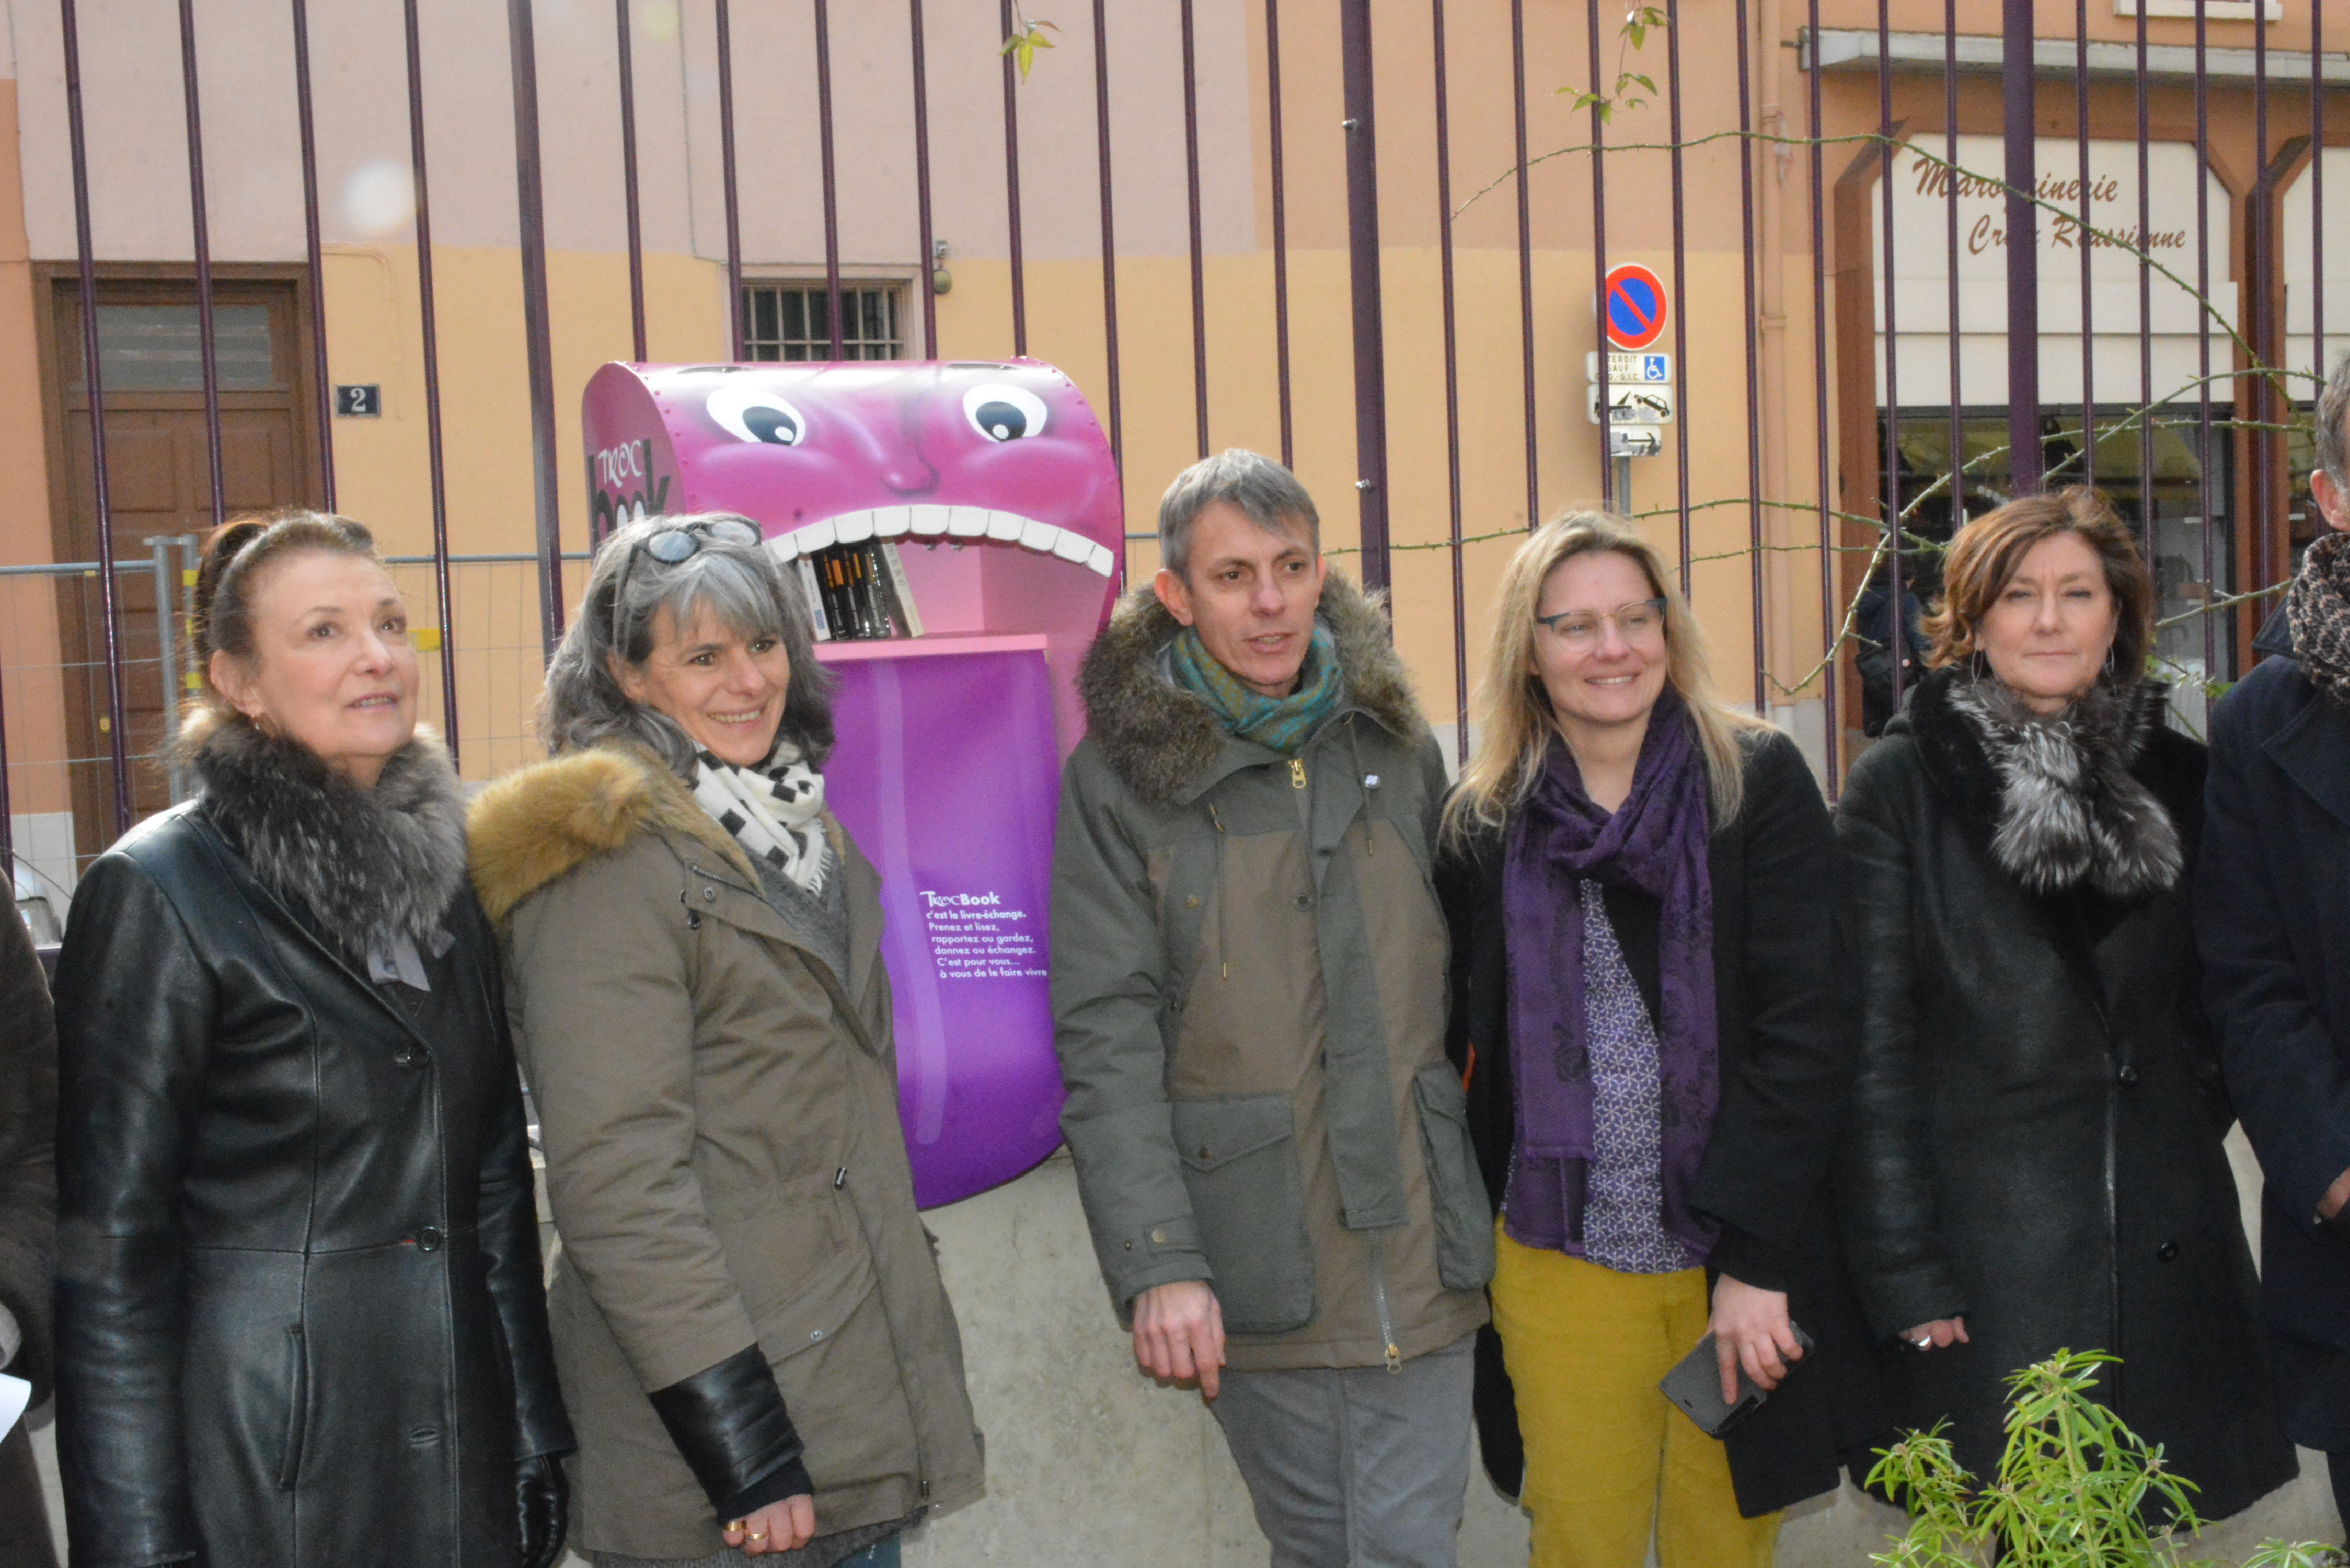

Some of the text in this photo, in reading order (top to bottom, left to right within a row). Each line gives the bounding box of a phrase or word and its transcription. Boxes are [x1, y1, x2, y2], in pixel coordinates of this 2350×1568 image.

[350, 388, 366, 412] 2
[598, 439, 642, 488] TROC
[926, 909, 1026, 920] c'est le livre-échange.
[929, 922, 962, 931] Prenez
[975, 921, 1000, 932] lisez,
[932, 935, 980, 945] rapportez
[996, 932, 1033, 944] gardez,
[935, 945, 970, 954] donnez
[988, 945, 1036, 956] échangez.
[937, 958, 961, 966] C'est
[964, 959, 986, 968] pour
[940, 970, 947, 978] à
[974, 967, 986, 977] de
[988, 967, 998, 976] le
[1000, 967, 1023, 976] faire
